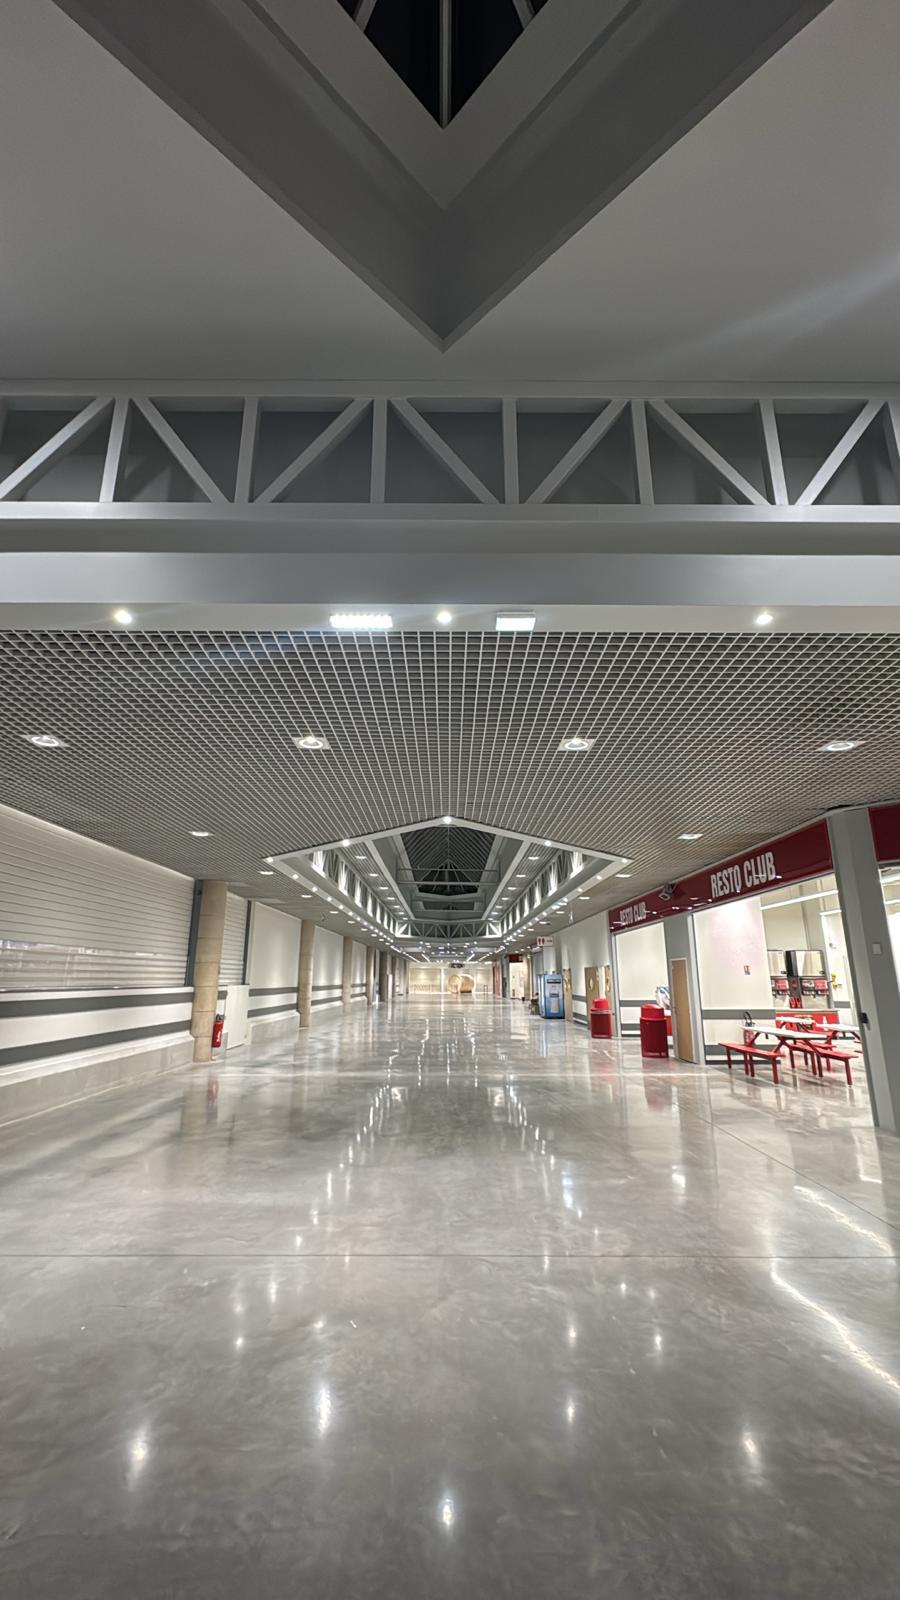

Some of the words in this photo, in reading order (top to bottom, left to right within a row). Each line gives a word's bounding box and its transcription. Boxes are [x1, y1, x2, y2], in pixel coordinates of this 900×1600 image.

[711, 865, 742, 898] RESTO
[743, 851, 775, 887] CLUB
[634, 901, 647, 922] CLUB
